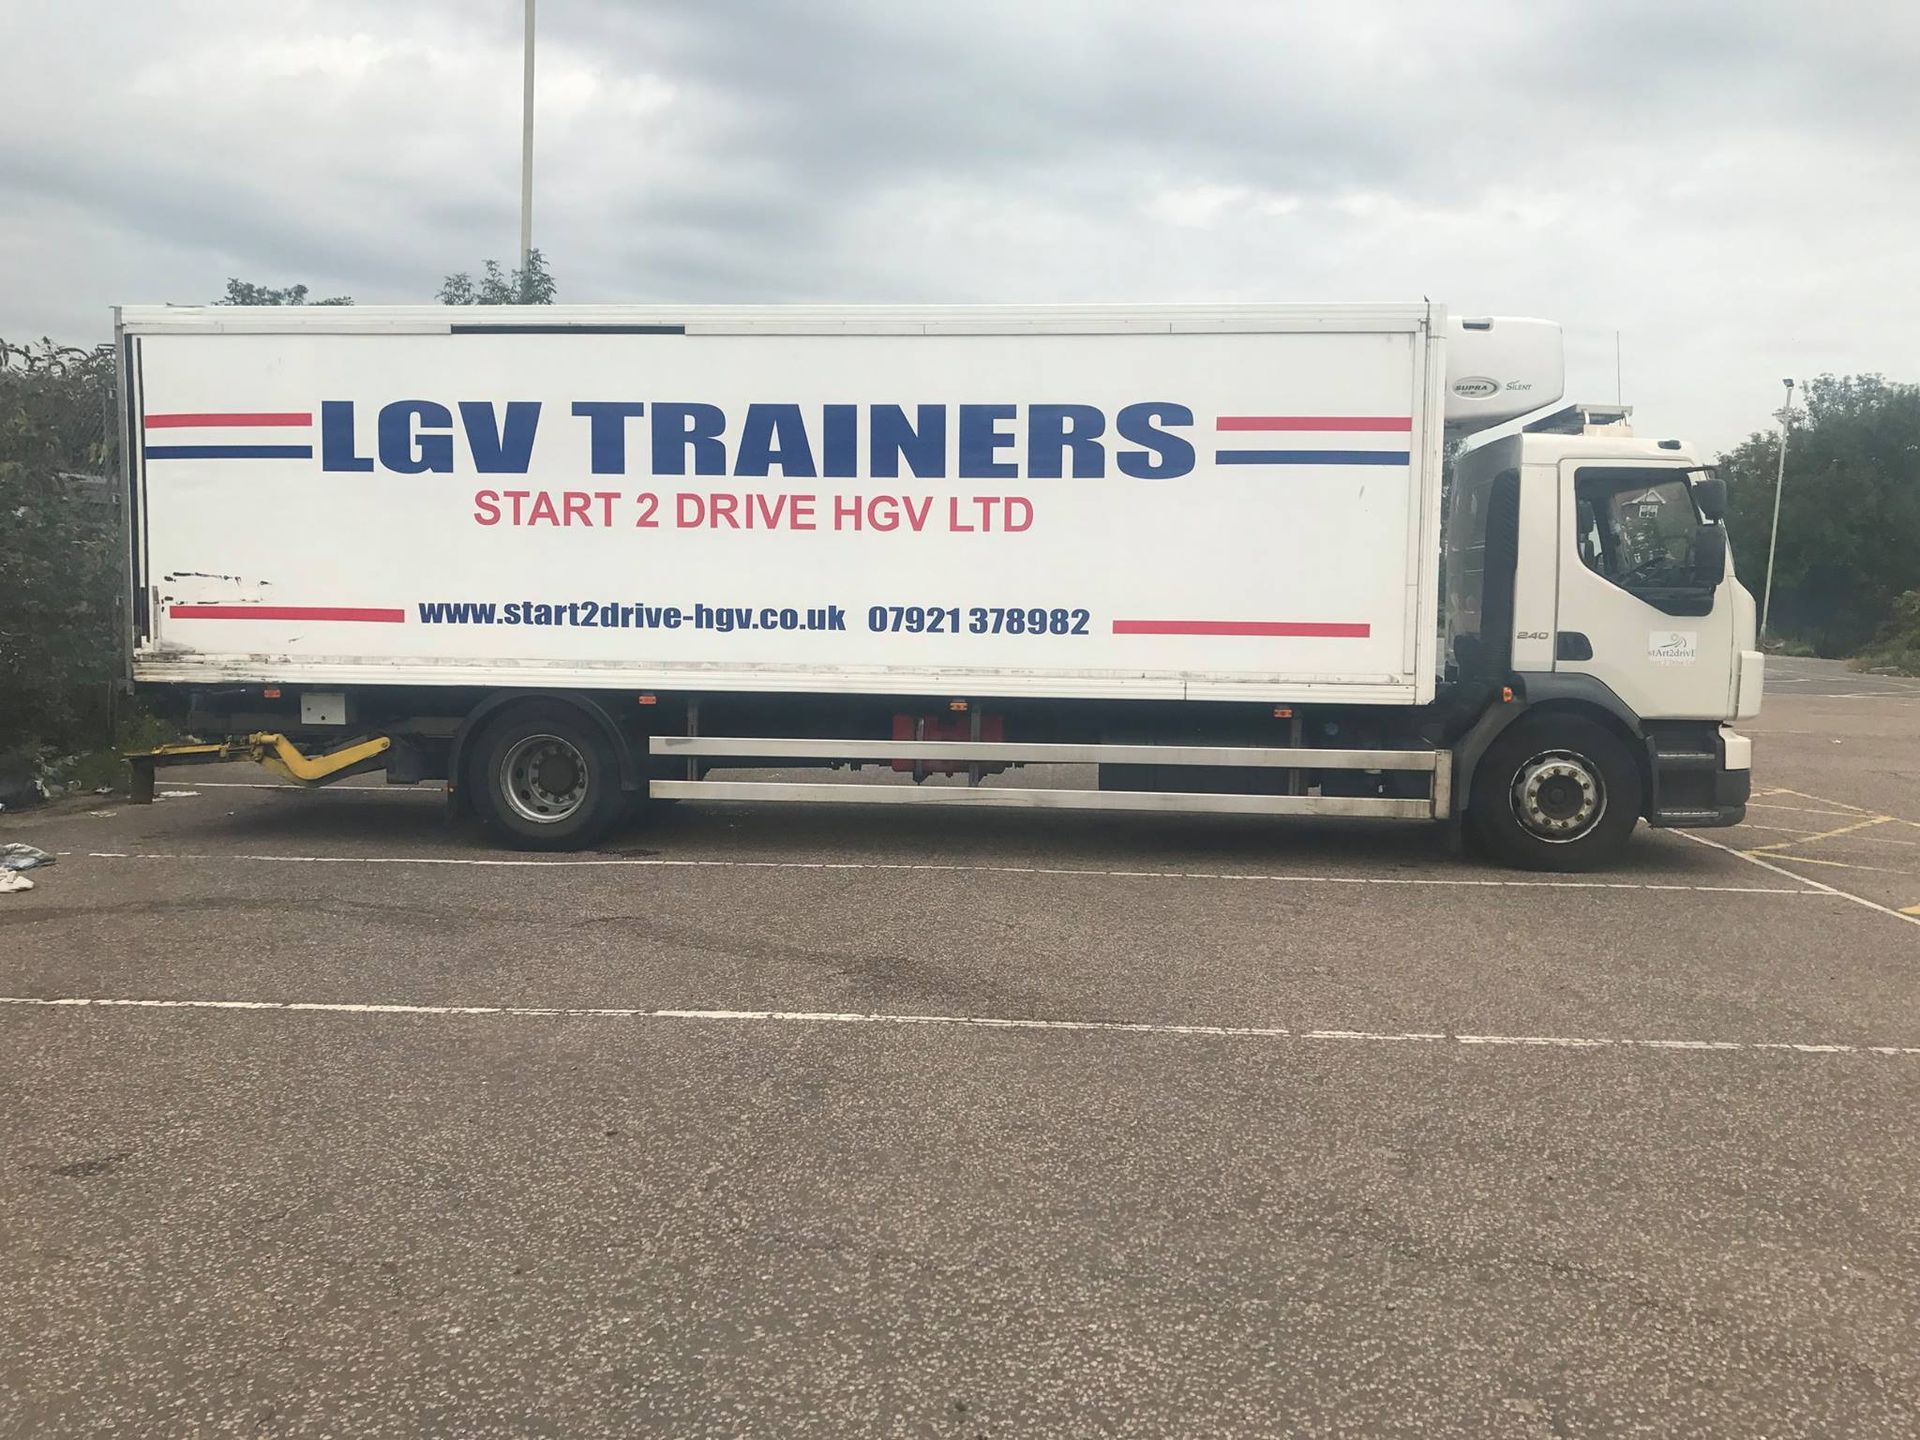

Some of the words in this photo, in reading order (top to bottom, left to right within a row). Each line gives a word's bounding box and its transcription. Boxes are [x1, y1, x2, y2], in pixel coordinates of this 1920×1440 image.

[321, 400, 541, 474] LGV
[572, 402, 1196, 480] TRAINERS
[474, 490, 621, 528] START
[637, 492, 658, 528] 2
[676, 492, 816, 530] DRIVE
[834, 495, 934, 532] HGV
[949, 496, 1034, 533] LTD
[418, 601, 846, 633] www.start2drive-hgv.co.uk
[868, 607, 960, 633] 07921
[969, 607, 1090, 635] 378982
[1517, 631, 1549, 640] 240
